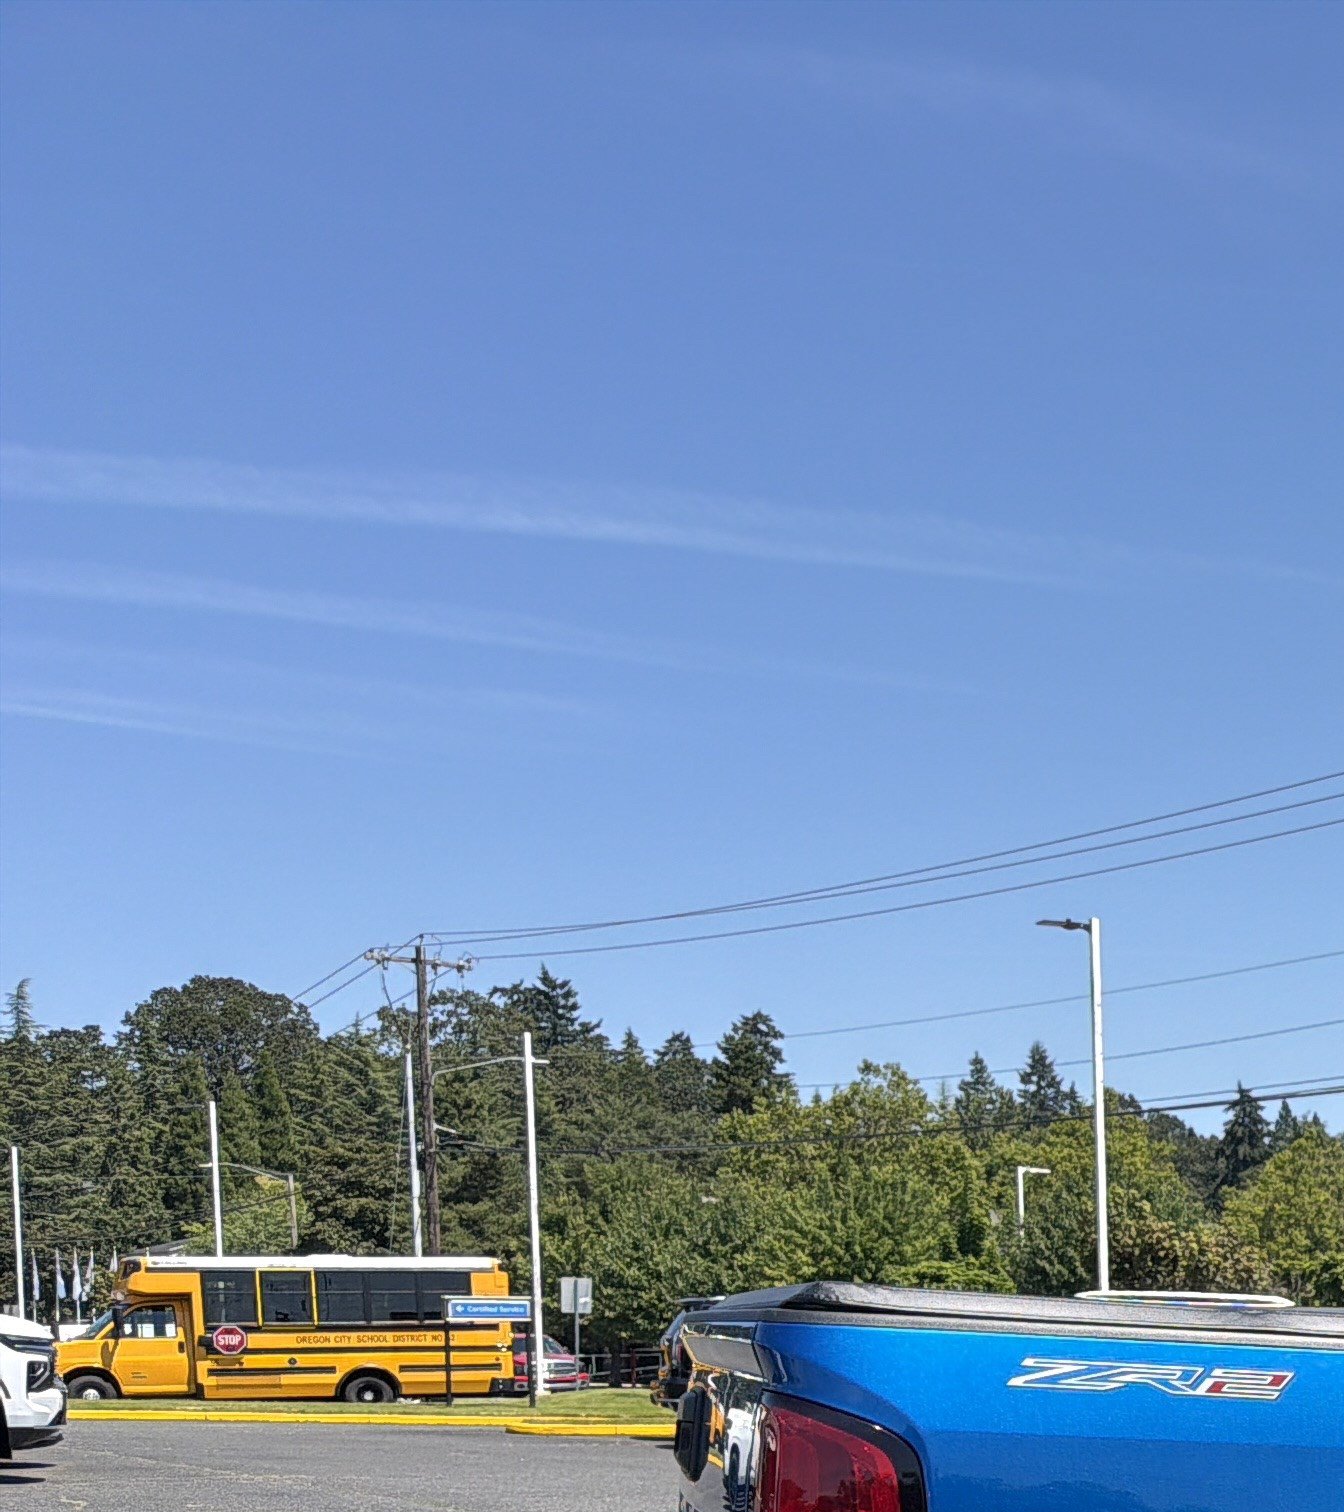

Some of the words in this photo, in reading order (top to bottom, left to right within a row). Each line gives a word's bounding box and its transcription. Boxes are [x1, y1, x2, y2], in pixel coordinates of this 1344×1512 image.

[218, 1334, 242, 1346] STOP
[295, 1335, 331, 1344] OREGON
[333, 1335, 352, 1344] CITY
[356, 1334, 388, 1343] SCHOOL
[392, 1333, 428, 1343] DISTRICT
[1006, 1357, 1297, 1400] ZR2
